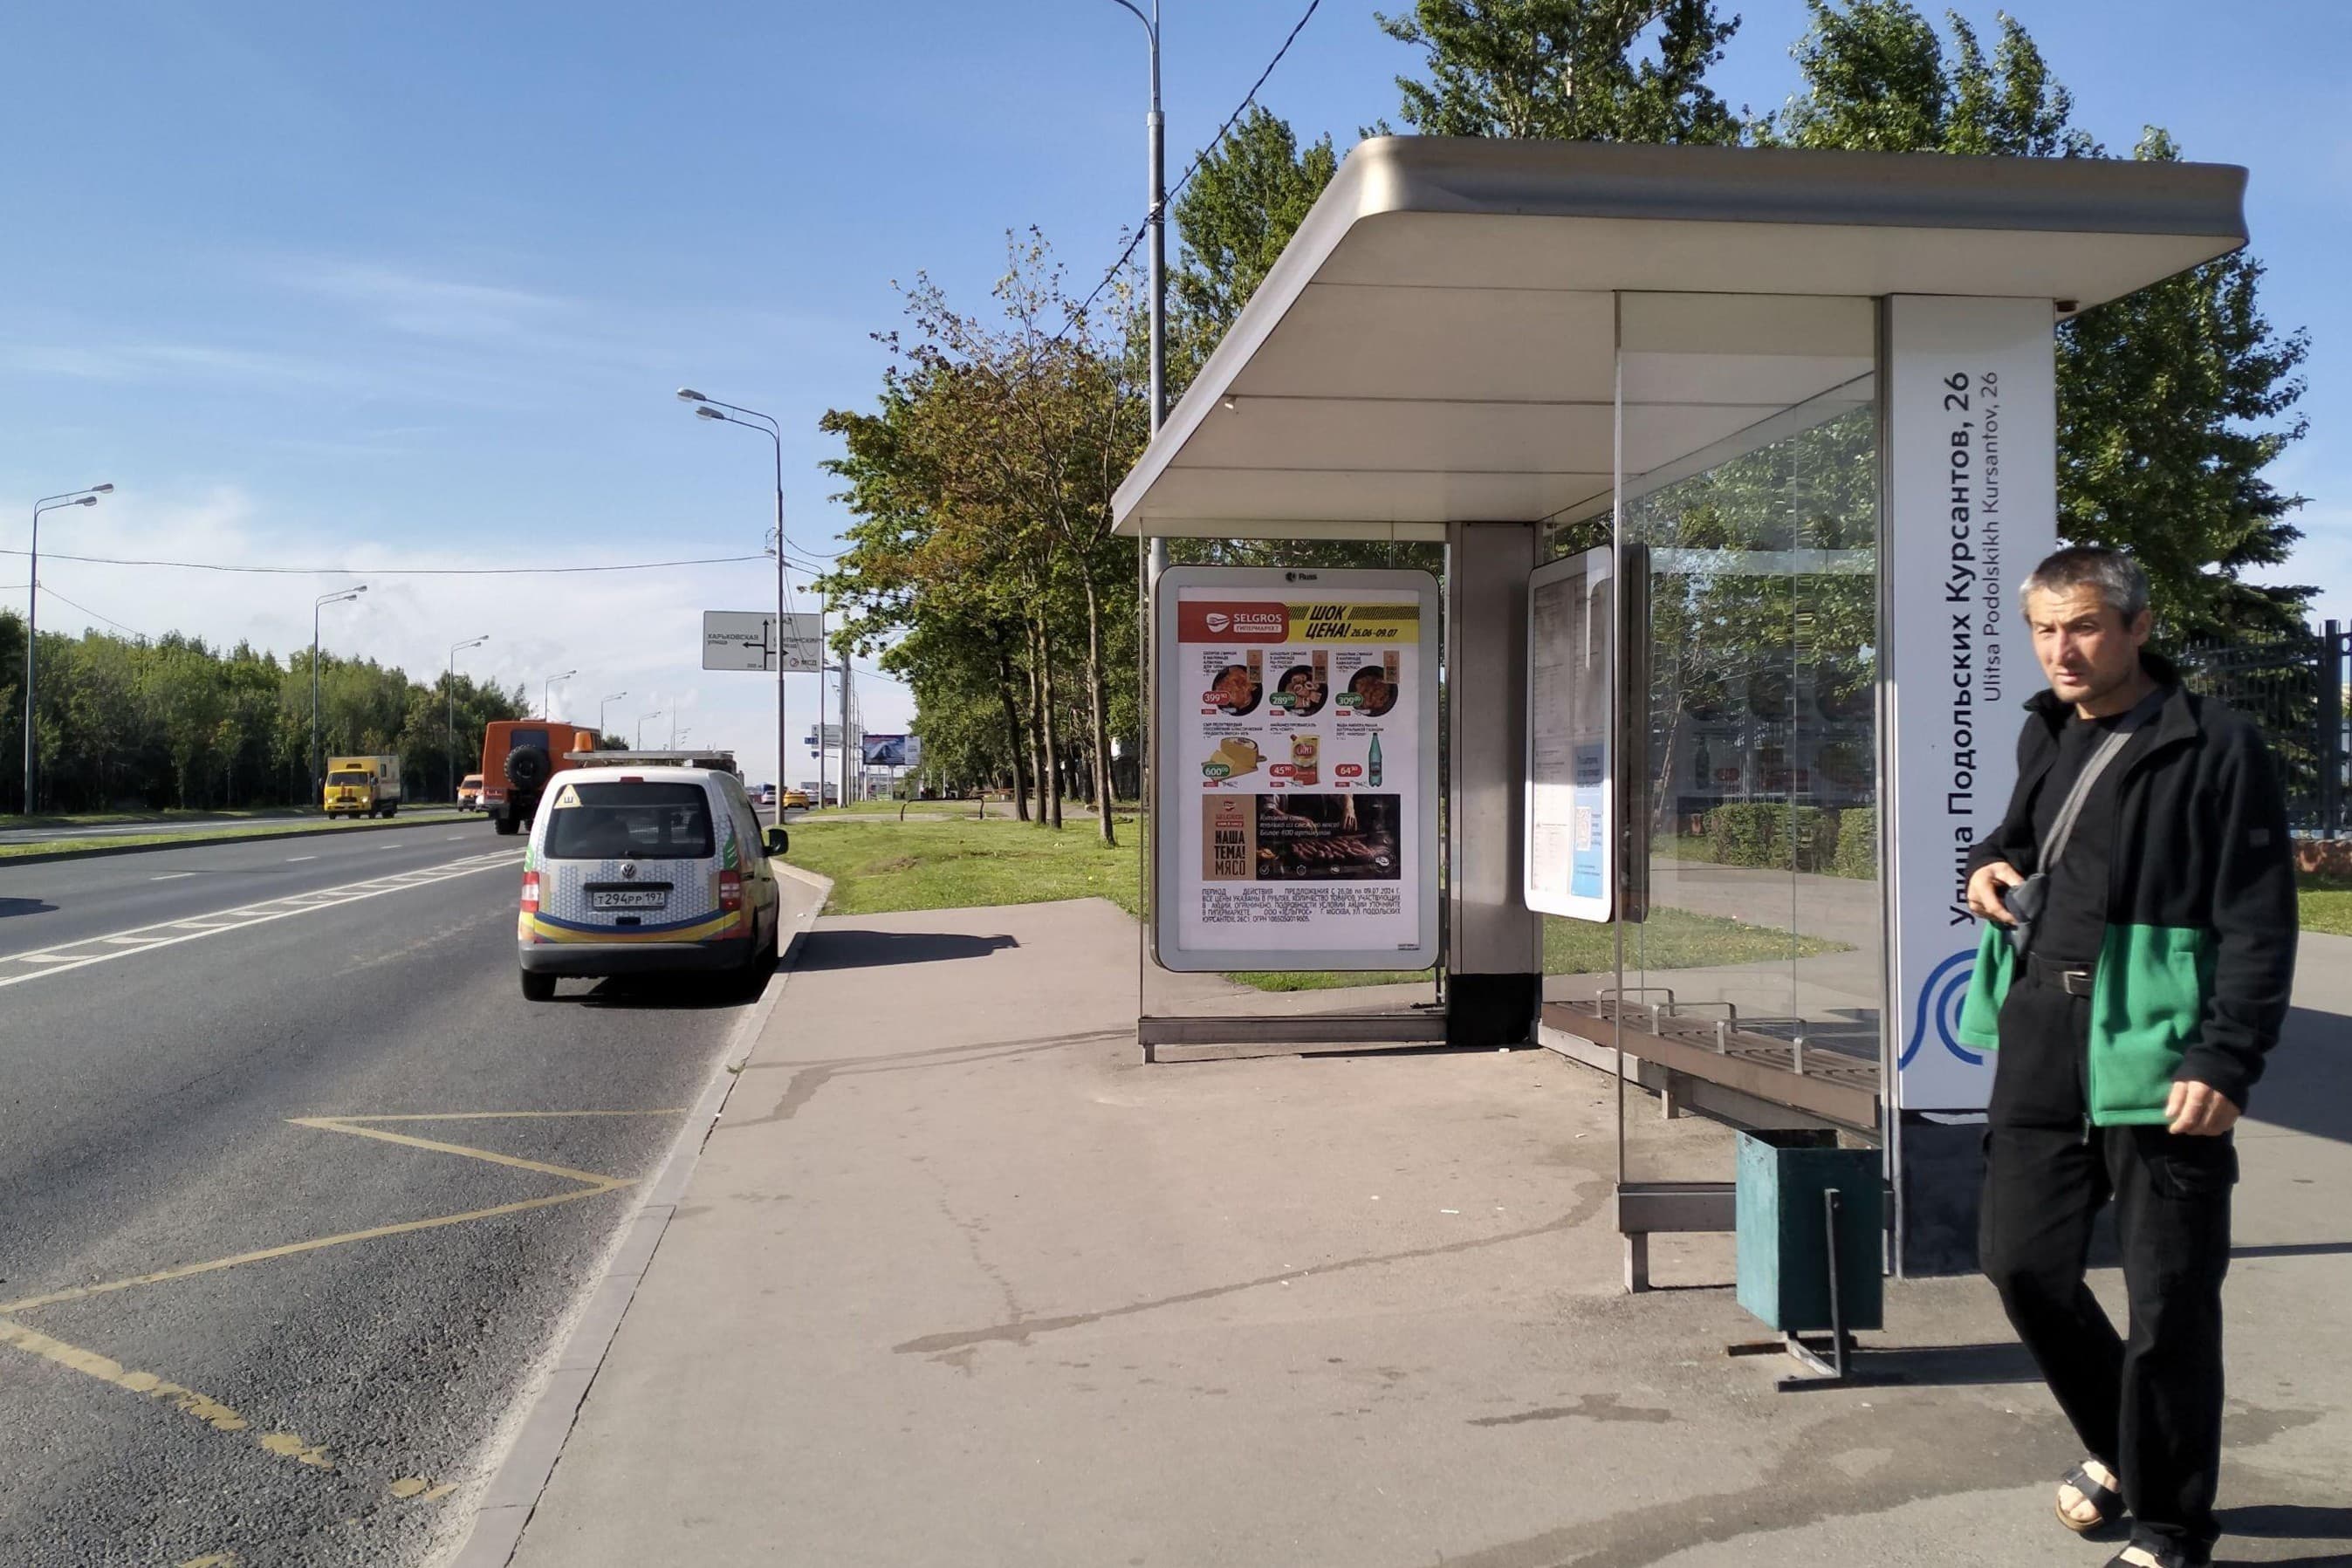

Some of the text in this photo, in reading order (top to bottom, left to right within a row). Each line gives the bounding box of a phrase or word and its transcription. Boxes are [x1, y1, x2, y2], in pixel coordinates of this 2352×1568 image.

[1944, 372, 1970, 411] 26
[1945, 421, 1977, 602] Курсантов,
[1981, 371, 2001, 702] Ulitsa Podolskikh Kursantov, 26
[1233, 613, 1282, 623] SELGROS
[1309, 606, 1347, 620] ШОК
[1305, 623, 1351, 640] ЦЕНА!
[1948, 613, 1977, 814] Подольских
[1205, 767, 1222, 776] 600
[1215, 830, 1245, 844] НАША
[1214, 846, 1245, 859] ТЕМА!
[1215, 860, 1245, 875] МЯСО
[597, 893, 662, 905] Т294РР 197
